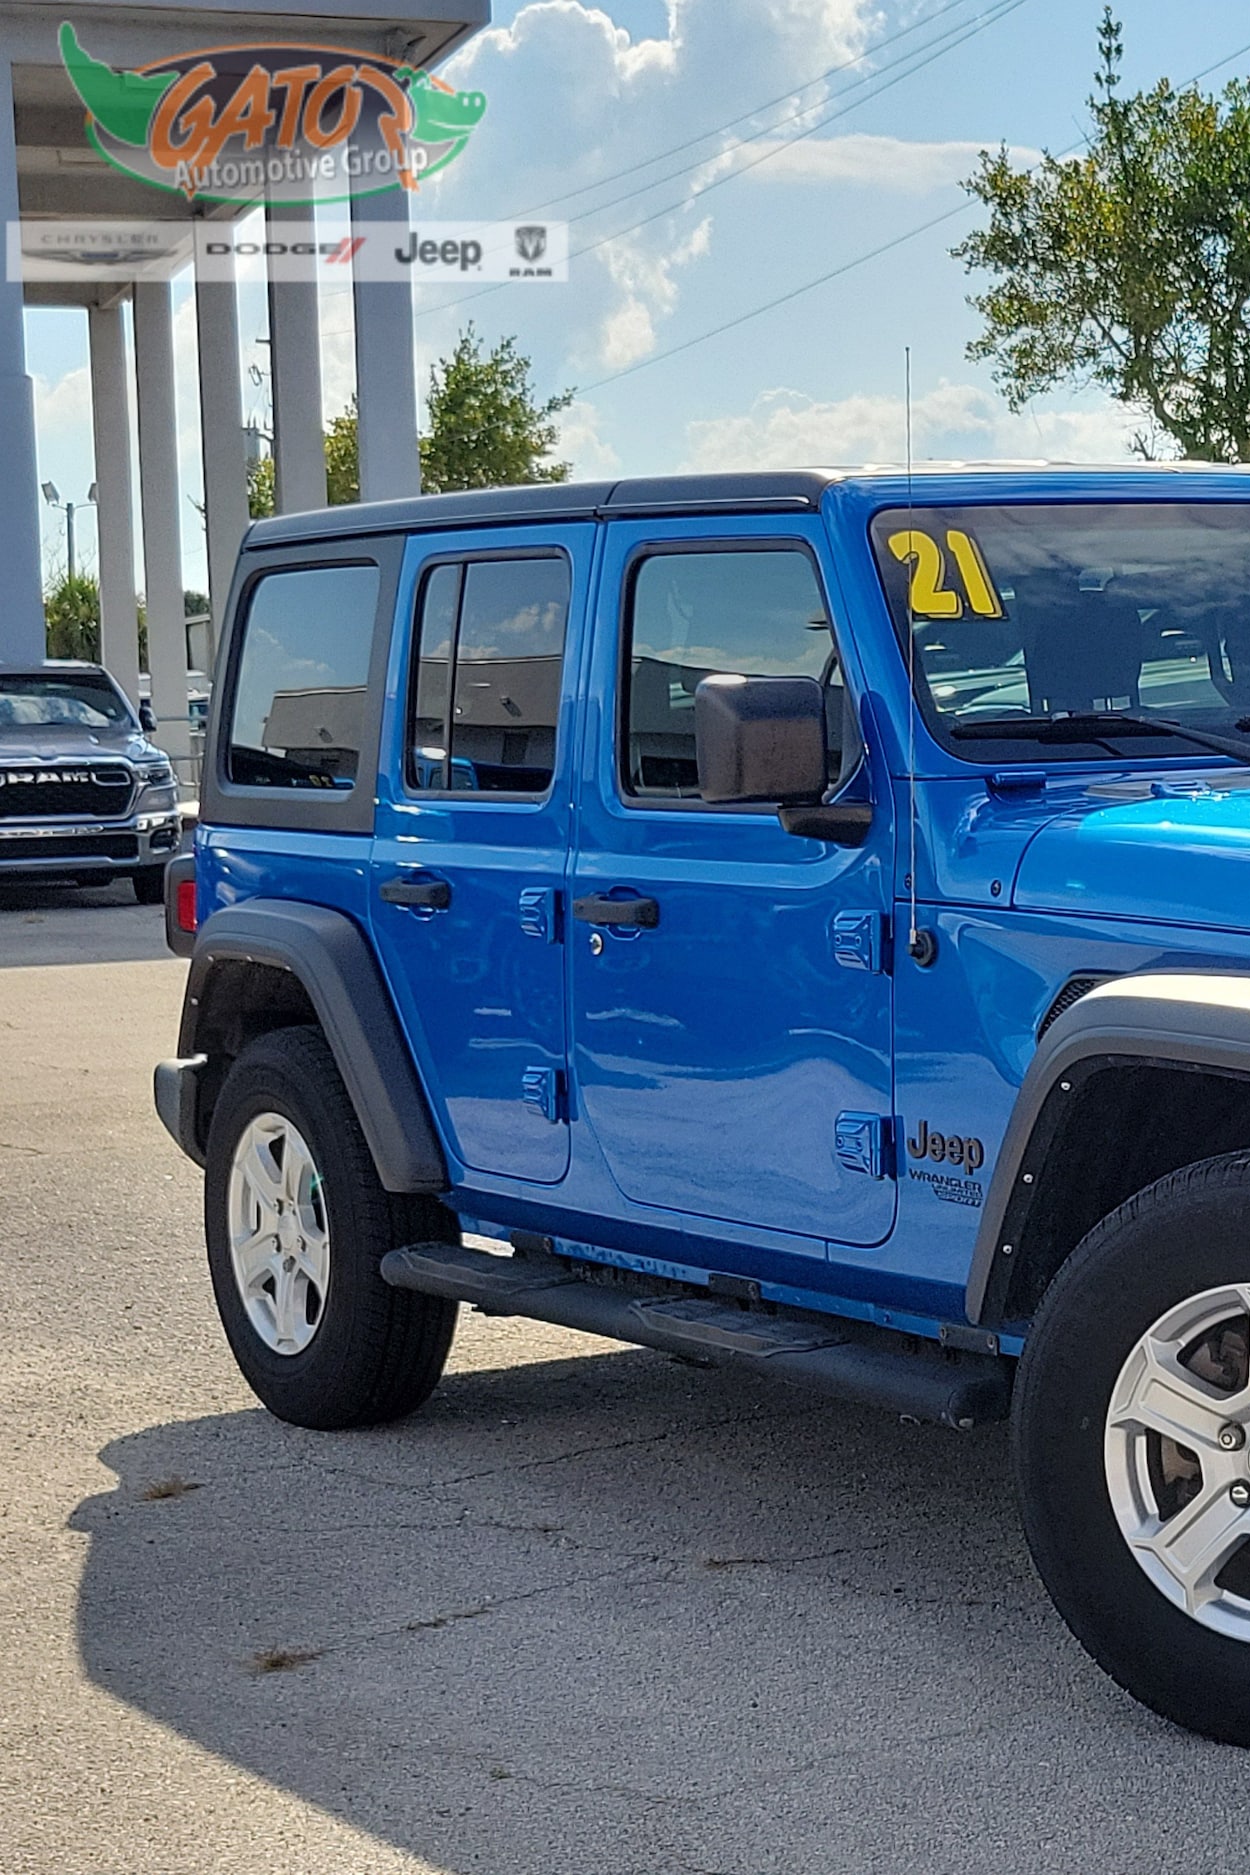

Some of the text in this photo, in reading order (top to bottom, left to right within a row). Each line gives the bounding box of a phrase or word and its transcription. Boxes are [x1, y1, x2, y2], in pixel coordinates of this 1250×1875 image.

[888, 530, 1002, 619] 21
[8, 771, 89, 784] RAM
[907, 1119, 984, 1175] Jeep
[909, 1168, 982, 1193] WRANGLER
